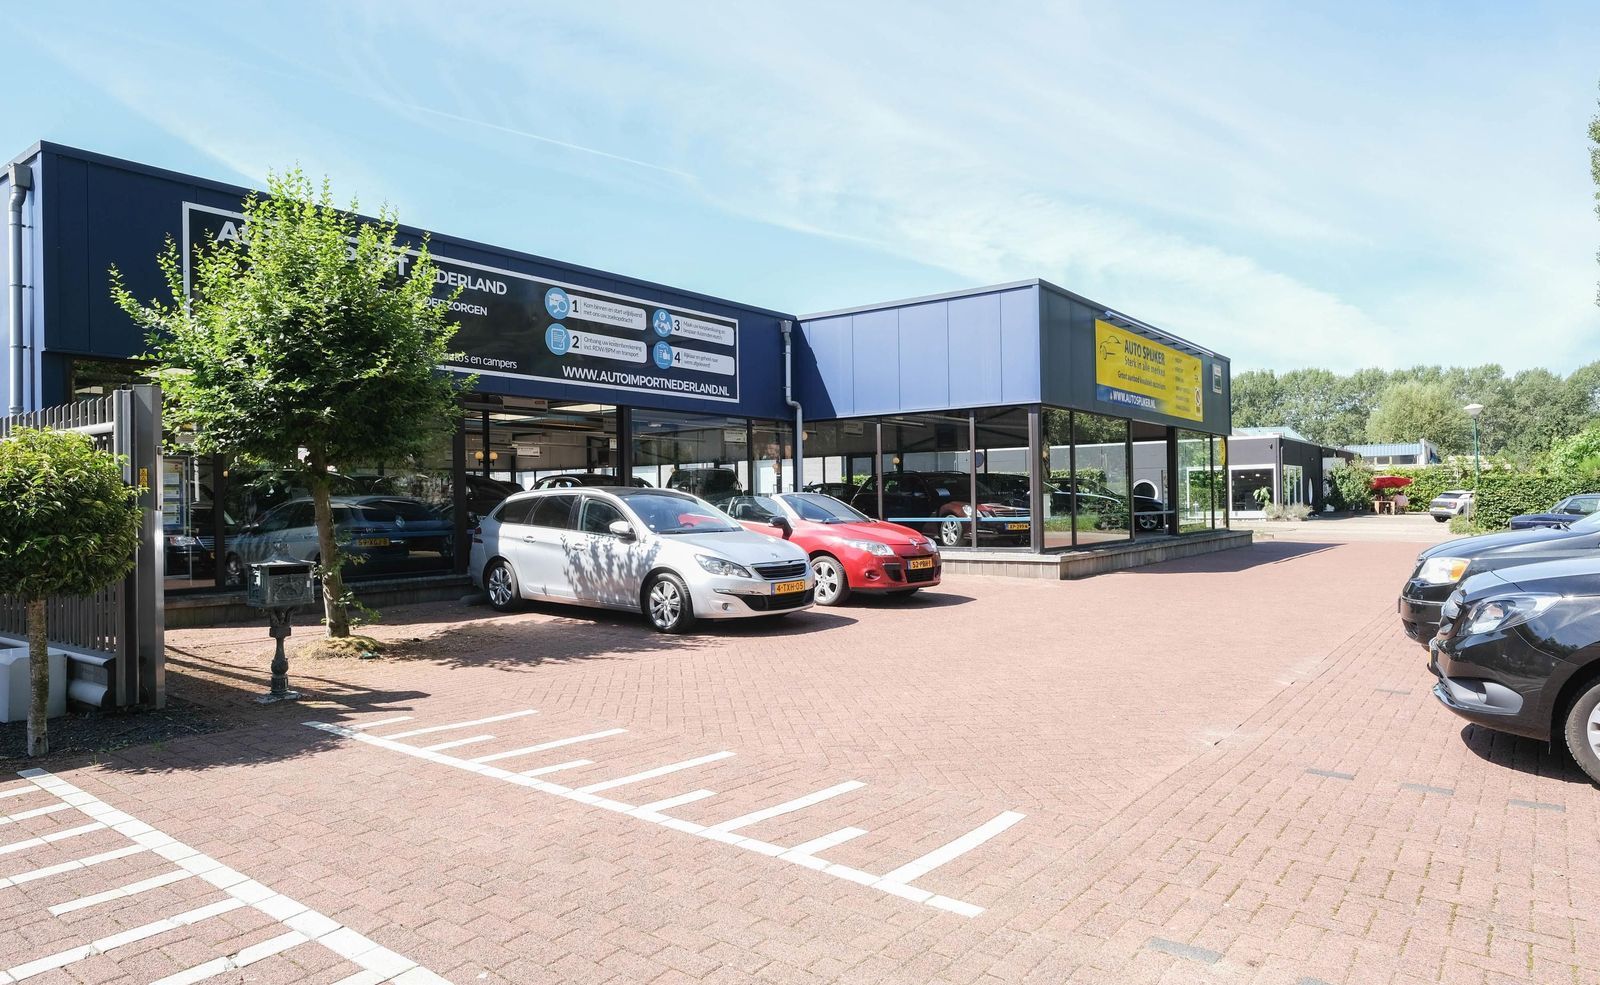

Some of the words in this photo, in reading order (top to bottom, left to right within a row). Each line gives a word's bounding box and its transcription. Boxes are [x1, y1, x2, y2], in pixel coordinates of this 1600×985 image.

[446, 300, 488, 316] ZORGEN
[572, 300, 579, 313] 1
[674, 320, 680, 331] 3
[572, 335, 580, 348] 2
[1125, 340, 1141, 357] AUTO
[470, 355, 482, 365] en
[482, 357, 518, 370] campers
[674, 352, 681, 364] 4
[562, 365, 730, 396] WWW.AUTOIMPORTNEDERLAND.NL
[776, 582, 804, 592] 4-TXH-05
